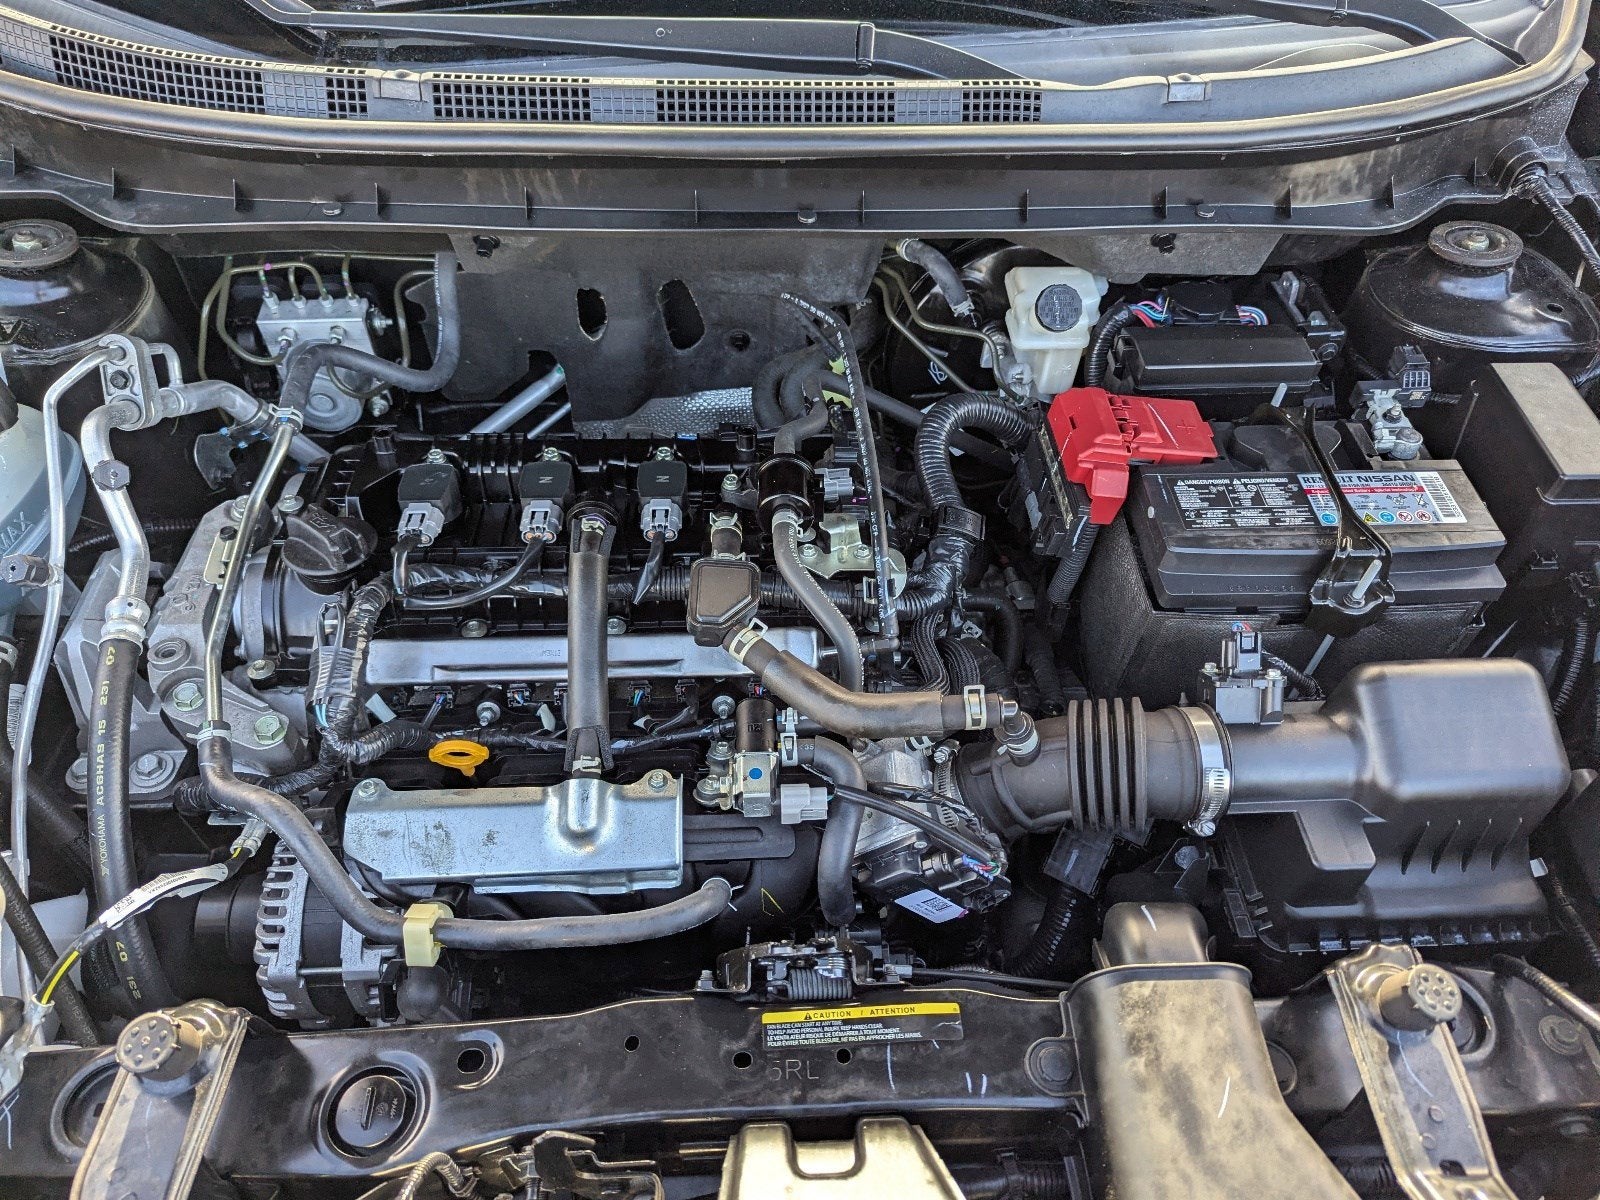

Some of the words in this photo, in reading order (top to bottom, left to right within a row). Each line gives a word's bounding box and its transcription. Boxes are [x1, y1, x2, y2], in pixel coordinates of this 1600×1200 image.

[1357, 474, 1415, 483] NISSAN
[99, 814, 108, 863] YOKOHAMA
[813, 1010, 852, 1019] CAUTION
[869, 1006, 916, 1016] ATTENTION
